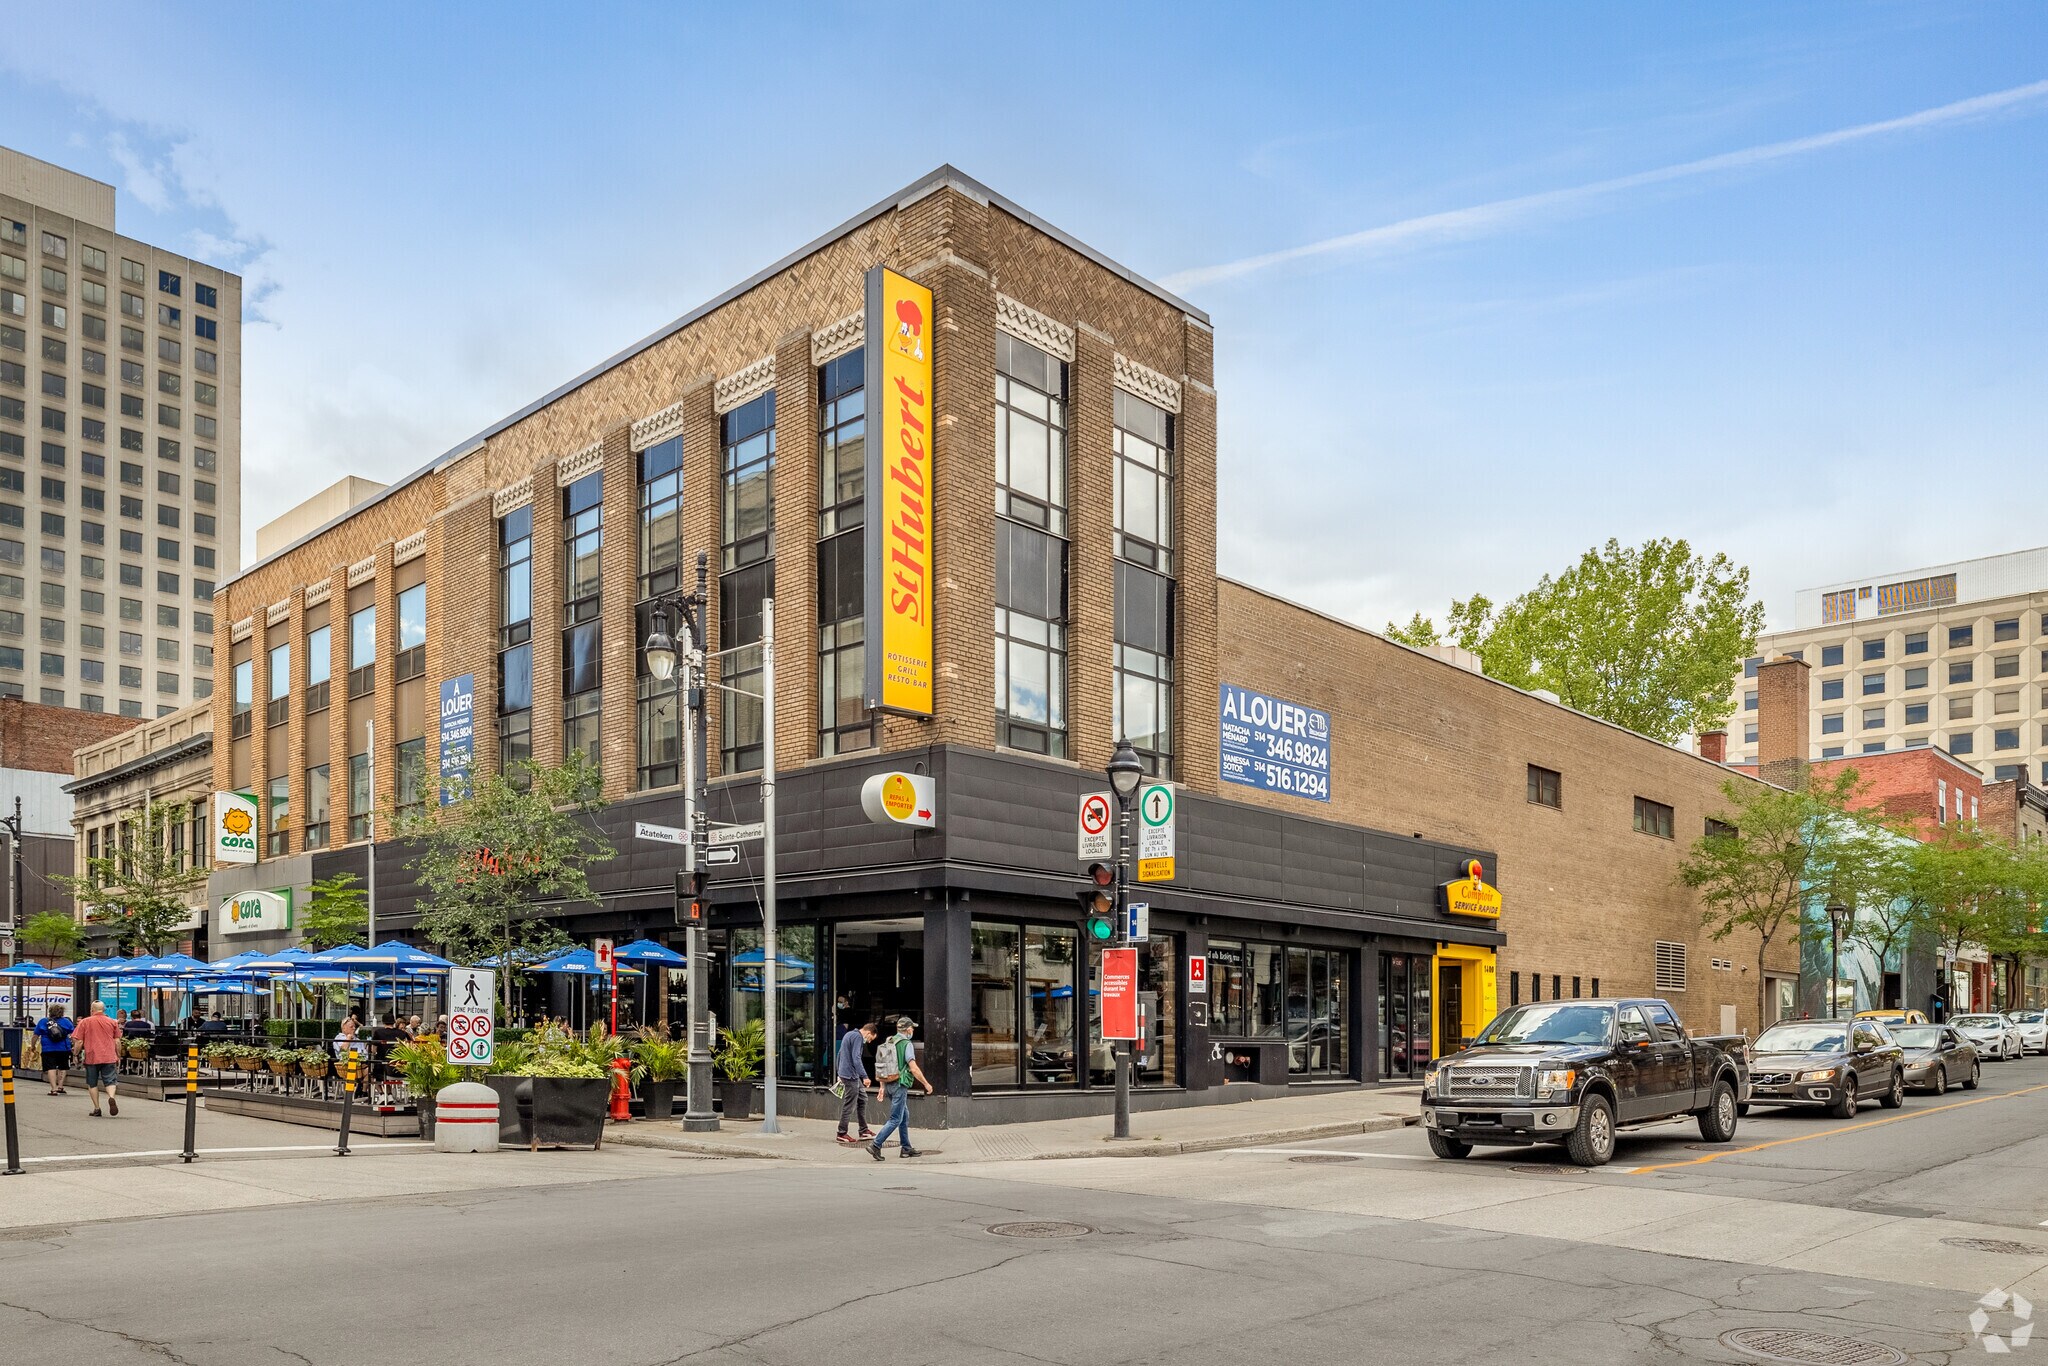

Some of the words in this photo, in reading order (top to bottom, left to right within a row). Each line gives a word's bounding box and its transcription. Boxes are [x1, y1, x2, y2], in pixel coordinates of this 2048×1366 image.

[897, 665, 917, 676] GRILL
[453, 679, 460, 696] À
[441, 692, 472, 717] LOUER
[1222, 687, 1238, 720] À
[1240, 692, 1307, 738] LOUER
[1222, 722, 1251, 737] NATACHA
[1254, 731, 1266, 743] 514
[1266, 734, 1328, 770] 346.9824
[1222, 753, 1251, 767] VANESSA
[1222, 761, 1244, 773] SOTOS
[1254, 761, 1266, 773] 514
[1266, 764, 1328, 798] 516.1294
[889, 794, 905, 802] REPAS
[885, 801, 913, 810] EMPORTER
[640, 828, 673, 841] Atateken
[718, 829, 762, 842] Sainte-Catherine
[221, 836, 255, 849] cora
[1145, 861, 1168, 869] NOUVELLE
[1142, 869, 1171, 878] SIGNALISATION
[1461, 885, 1494, 904] Comptoir
[240, 898, 262, 919] cora
[1454, 901, 1478, 911] SERVICE
[1478, 904, 1499, 914] RAPIDE
